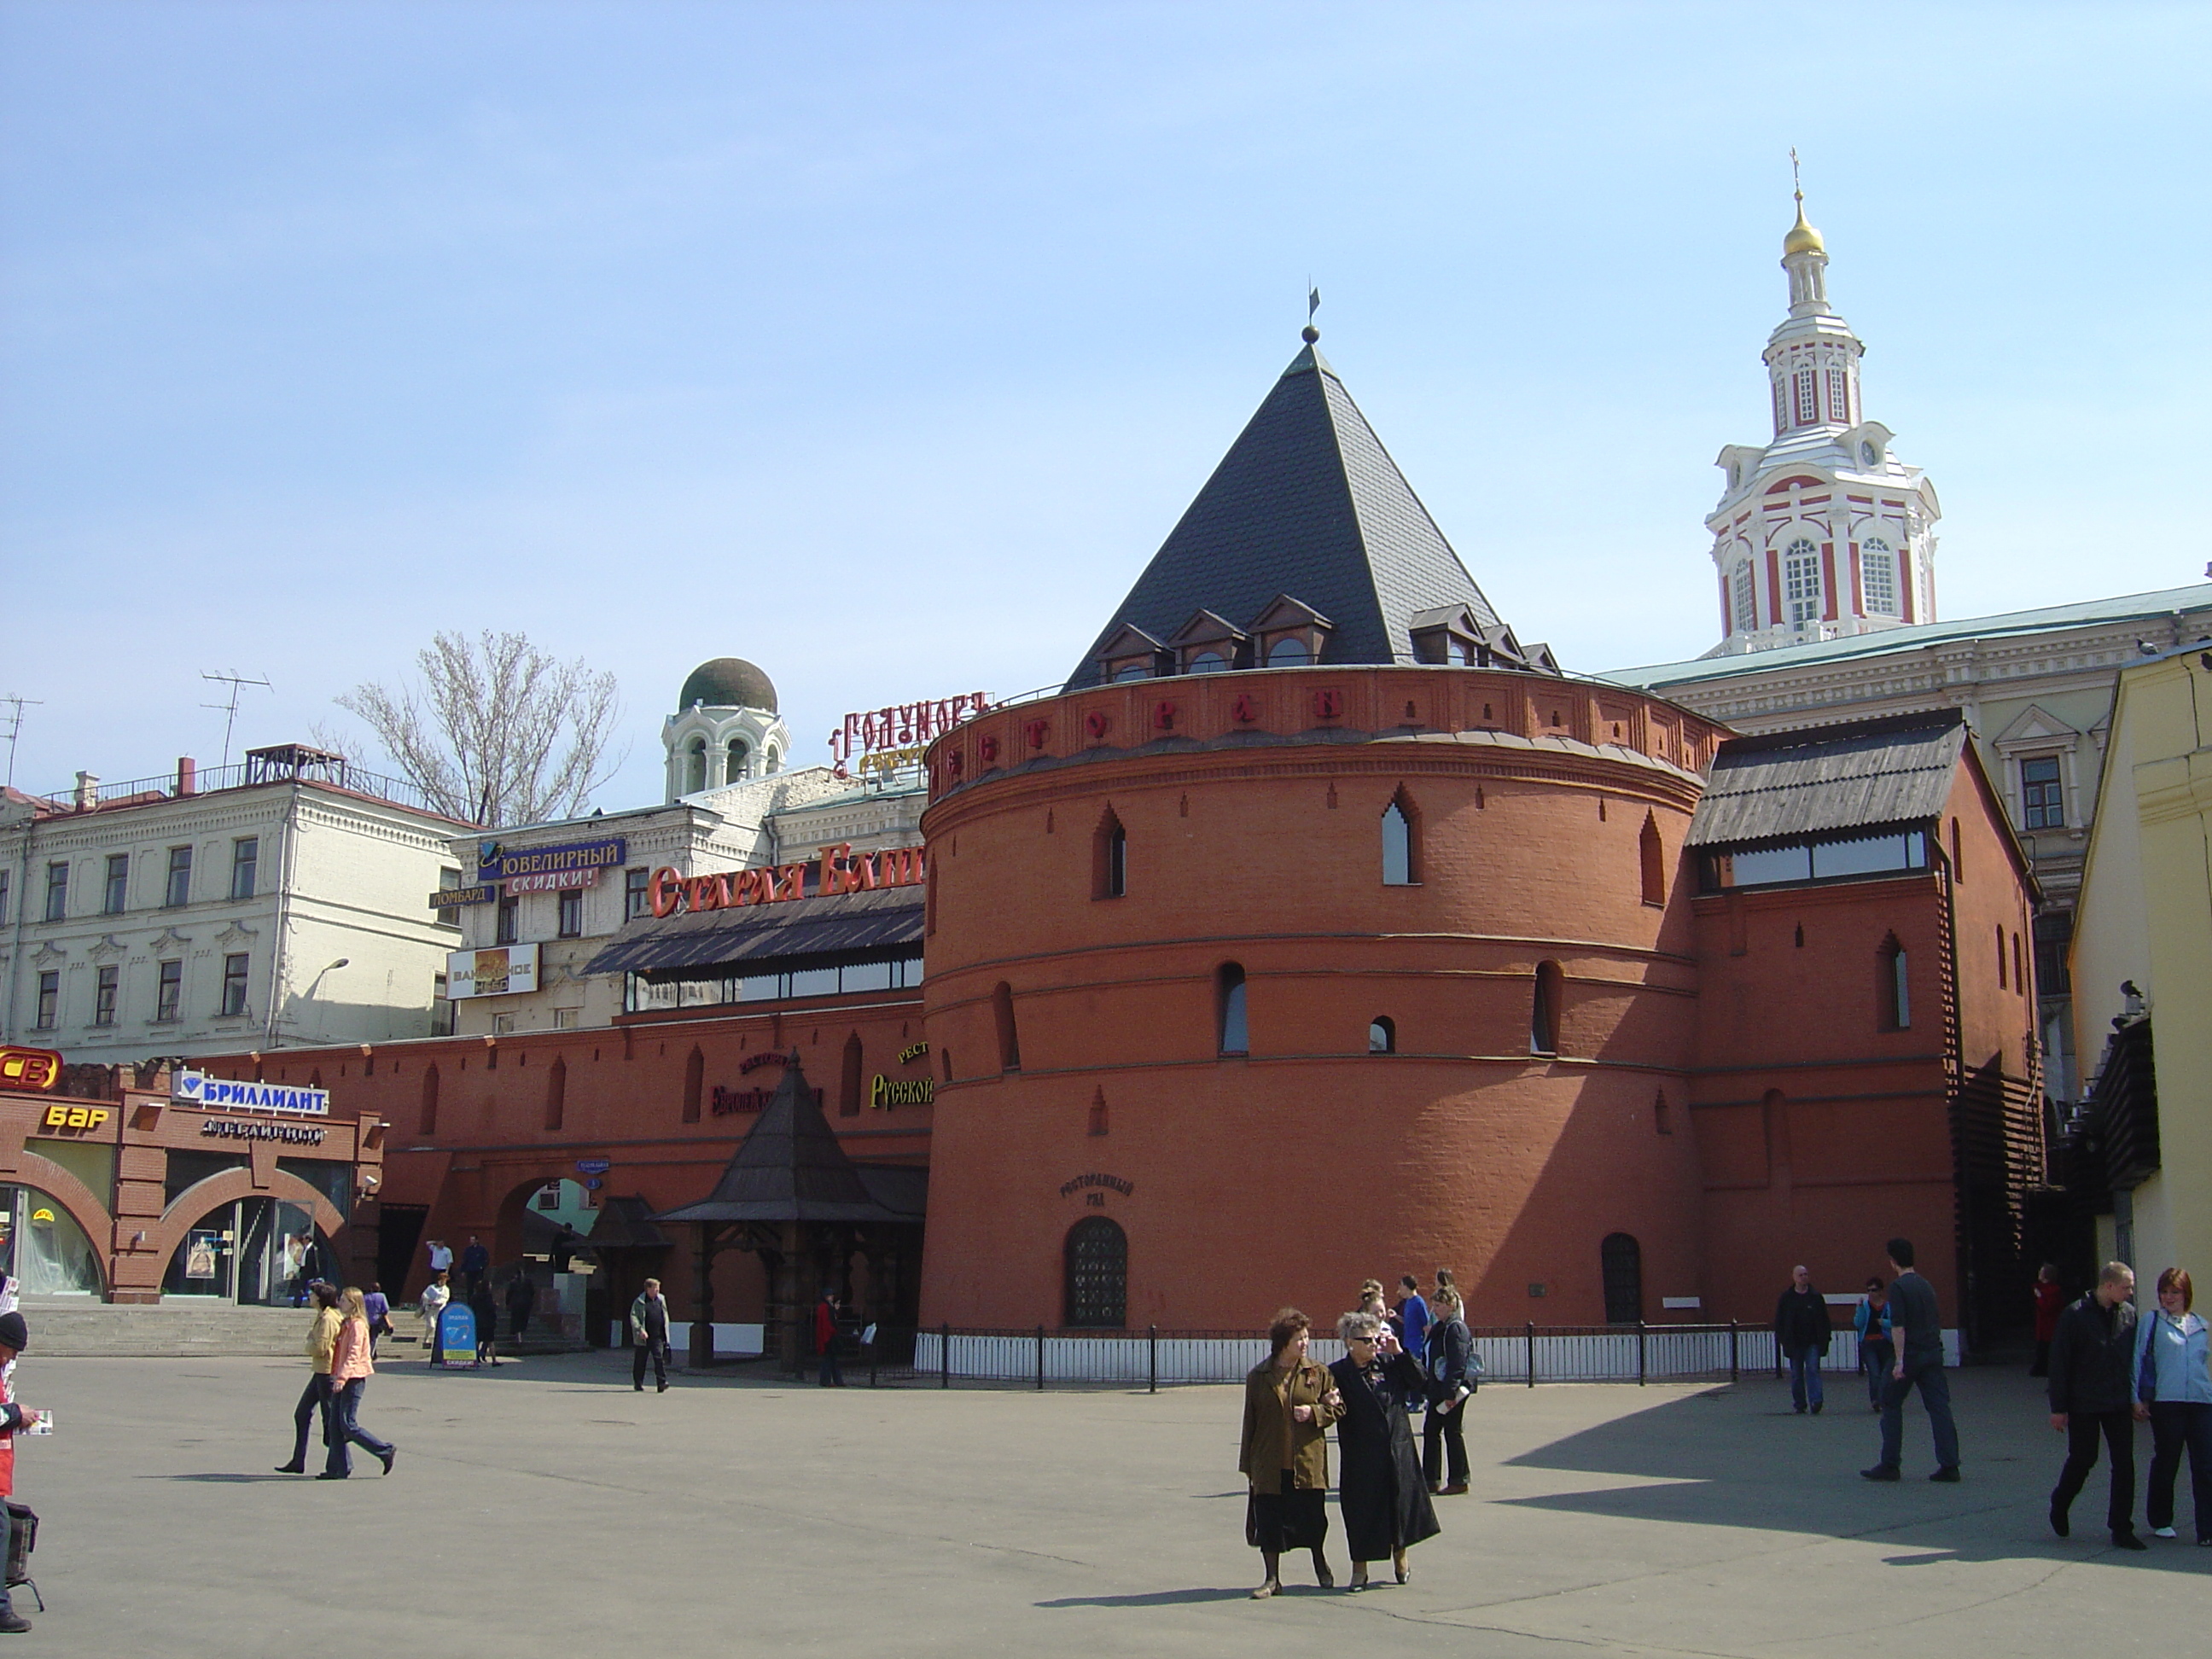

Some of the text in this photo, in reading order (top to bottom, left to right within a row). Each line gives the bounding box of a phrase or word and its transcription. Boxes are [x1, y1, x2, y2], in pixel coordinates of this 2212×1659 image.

[502, 843, 619, 876] ЮВЕЛИРНЫЙ
[512, 869, 594, 893] СКИДКИ!
[433, 886, 486, 906] ЛОМБАРД
[203, 1082, 326, 1111] БРИЛЛИАНТ
